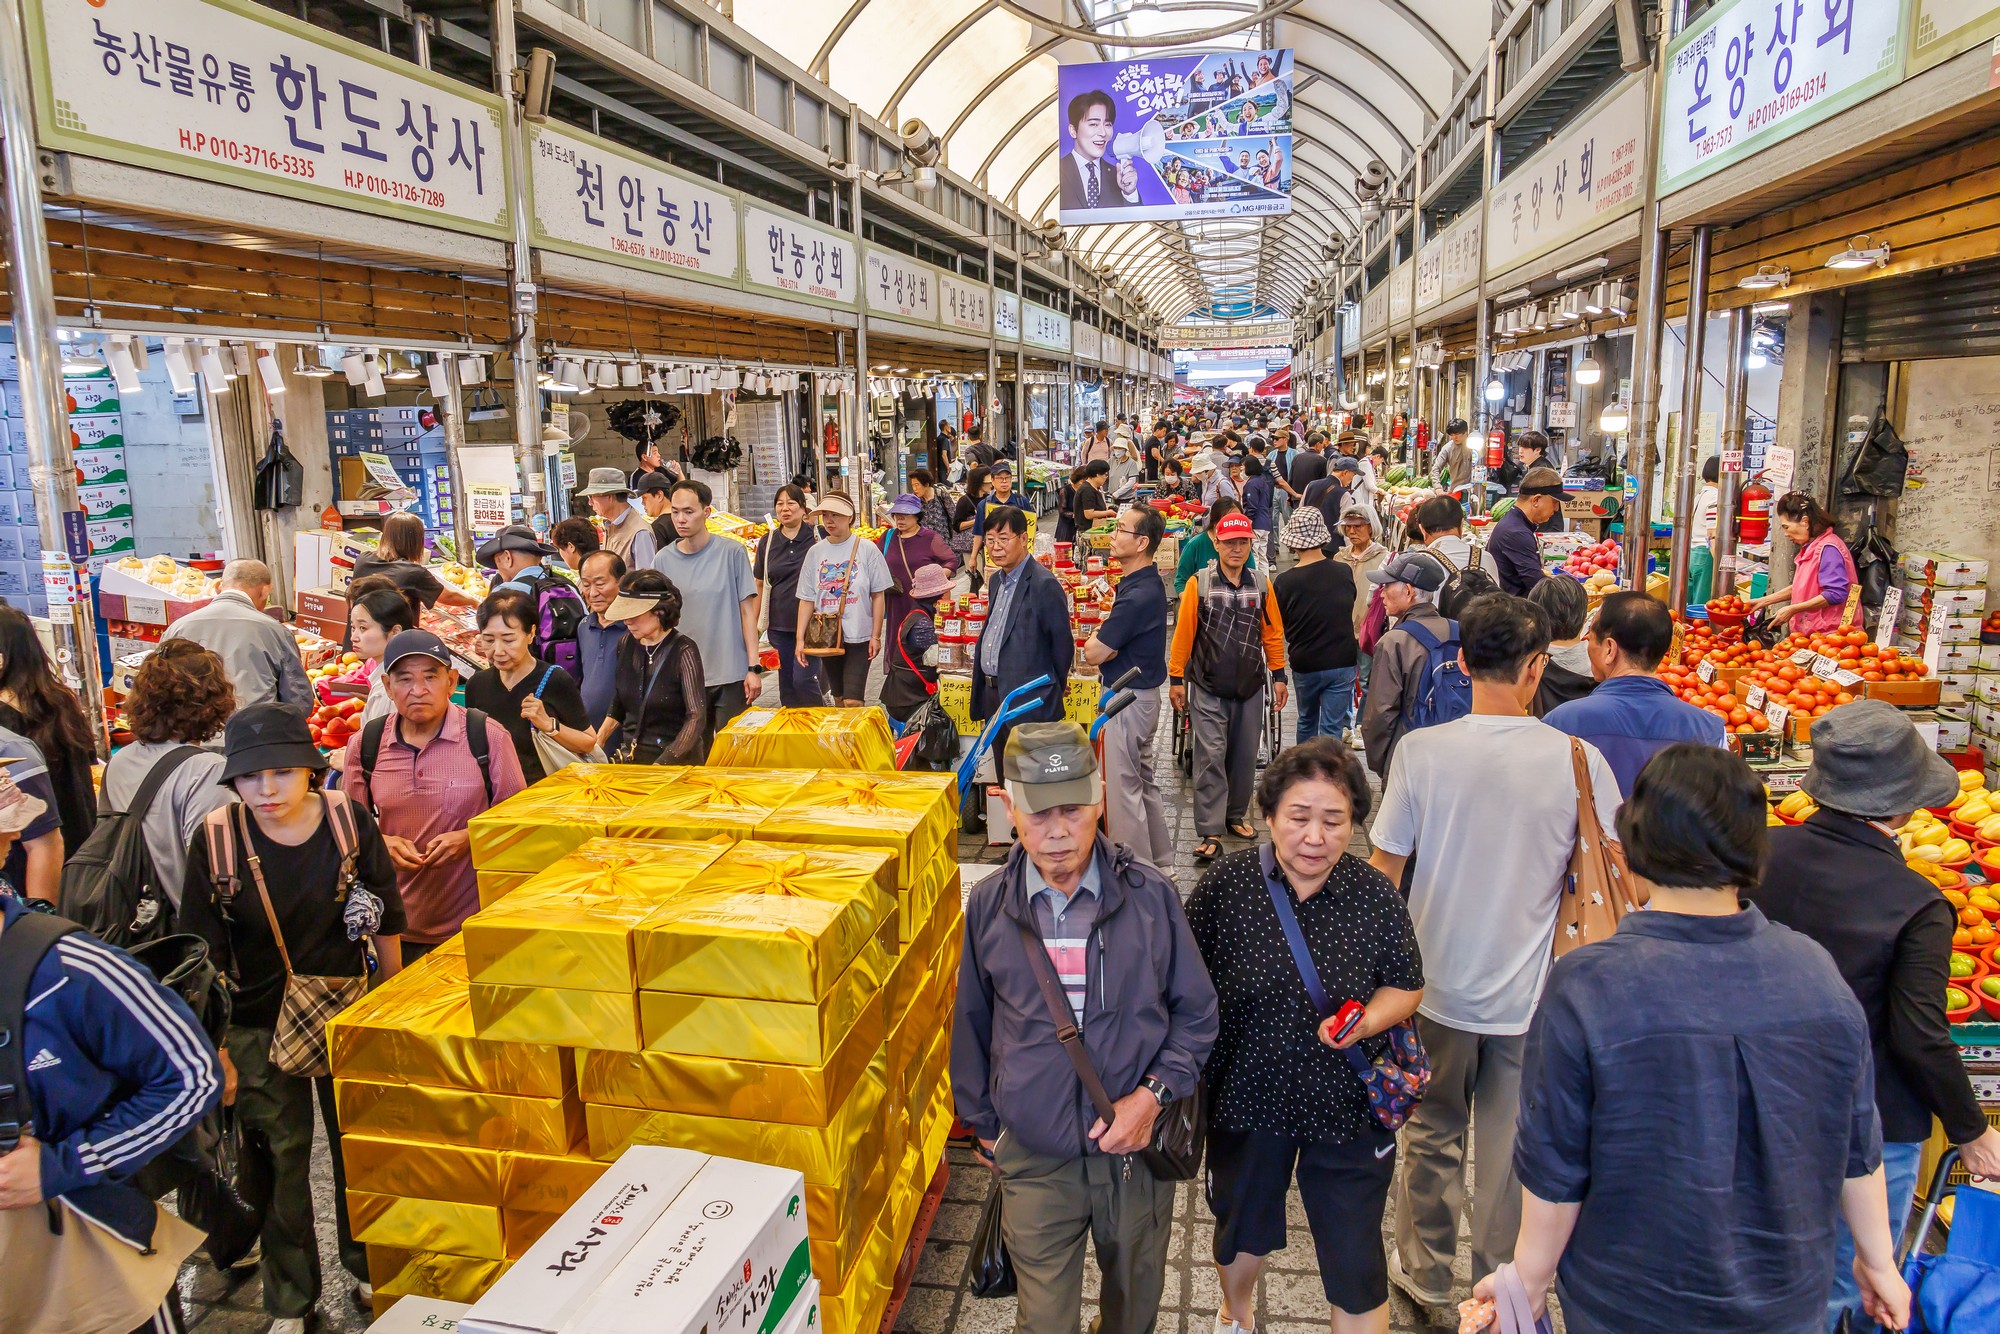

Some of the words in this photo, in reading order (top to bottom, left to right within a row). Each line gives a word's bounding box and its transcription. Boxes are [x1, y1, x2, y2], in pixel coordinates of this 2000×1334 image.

[1677, 26, 1717, 74] 청과위탁판매
[1111, 64, 1151, 92] 전국팔도
[92, 18, 256, 114] 농산물유통
[270, 54, 486, 196] 한도상사
[1748, 108, 1761, 133] H.P
[1762, 71, 1827, 126] 010-9169-0314
[179, 128, 206, 153] H.P
[210, 138, 315, 178] 010-3716-5335
[344, 169, 364, 190] H.P
[366, 175, 446, 208] 010-3126-7289
[576, 159, 713, 255] 천안농산
[1255, 203, 1285, 211] 새마을금고
[1512, 138, 1595, 245] 중앙상회
[768, 225, 843, 289] 한농상회
[880, 264, 928, 310] 우성상회
[88, 430, 106, 438] 사과
[92, 465, 109, 474] 사과
[96, 500, 114, 508] 사과
[473, 498, 505, 509] 환급행사
[474, 510, 505, 521] 참여점포
[101, 534, 118, 543] 사과
[1223, 519, 1248, 528] BRAVO
[1044, 765, 1069, 773] PLAYER
[546, 1227, 607, 1277] 사과
[742, 1266, 777, 1328] 사과
